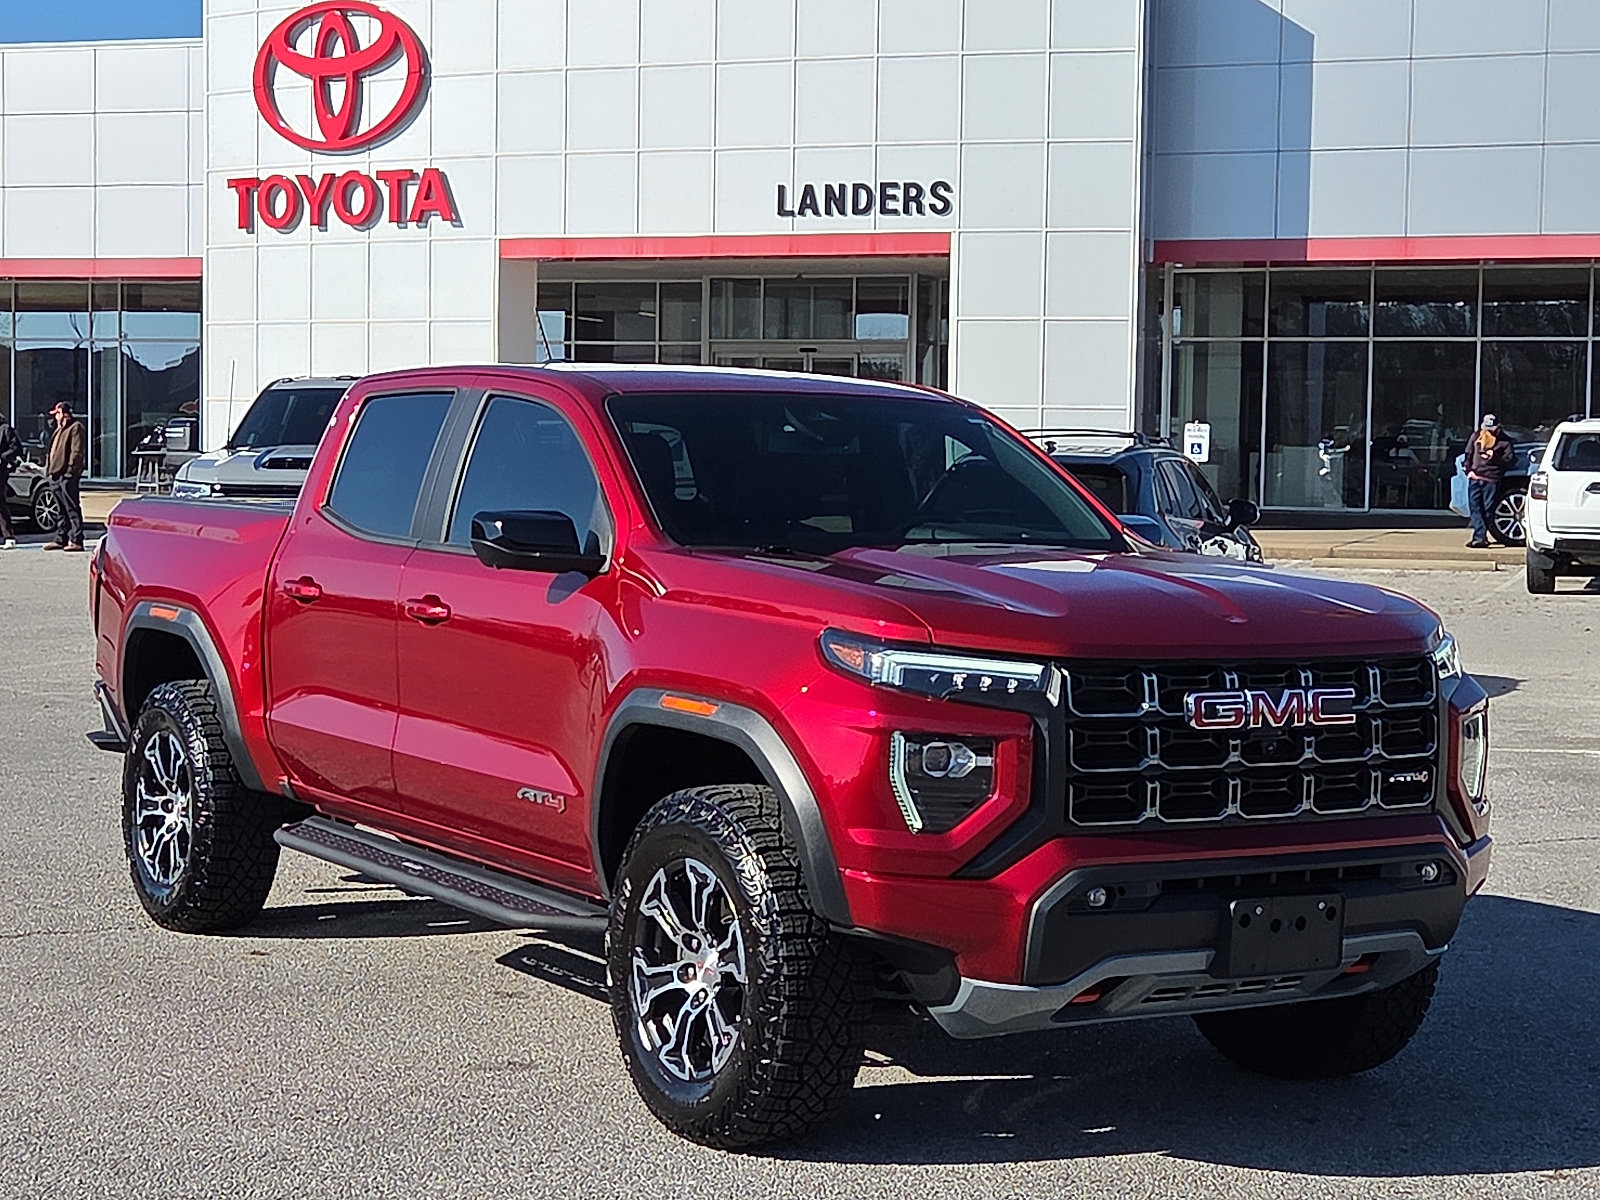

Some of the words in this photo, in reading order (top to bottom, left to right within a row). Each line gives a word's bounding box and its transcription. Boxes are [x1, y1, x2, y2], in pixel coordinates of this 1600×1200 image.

[227, 168, 461, 232] TOYOTA
[777, 181, 953, 217] LANDERS
[1184, 688, 1356, 730] GMC
[517, 787, 566, 813] AT4
